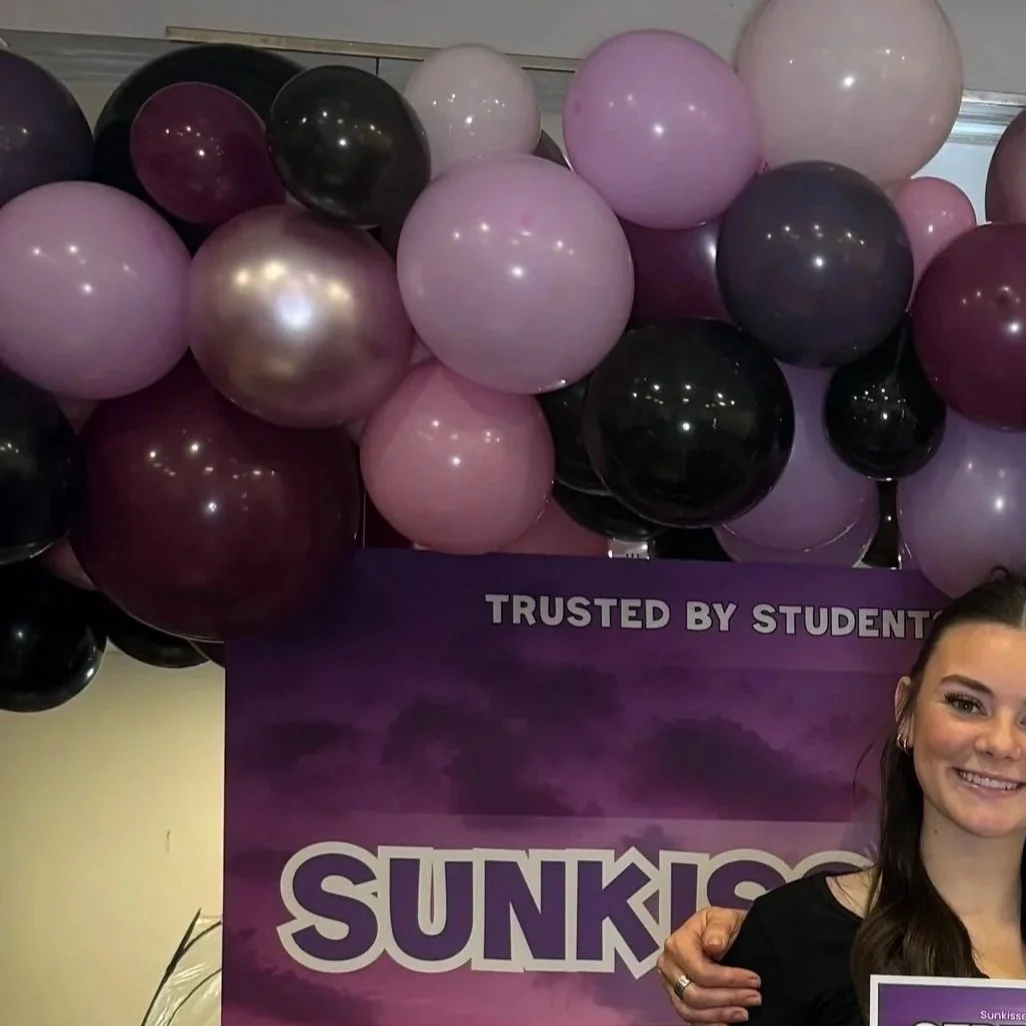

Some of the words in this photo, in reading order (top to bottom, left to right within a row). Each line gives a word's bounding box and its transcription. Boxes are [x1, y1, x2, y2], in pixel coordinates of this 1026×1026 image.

[485, 594, 669, 630] TRUSTED
[686, 601, 737, 632] BY
[752, 604, 943, 640] STUDENT
[277, 842, 877, 979] SUNKI
